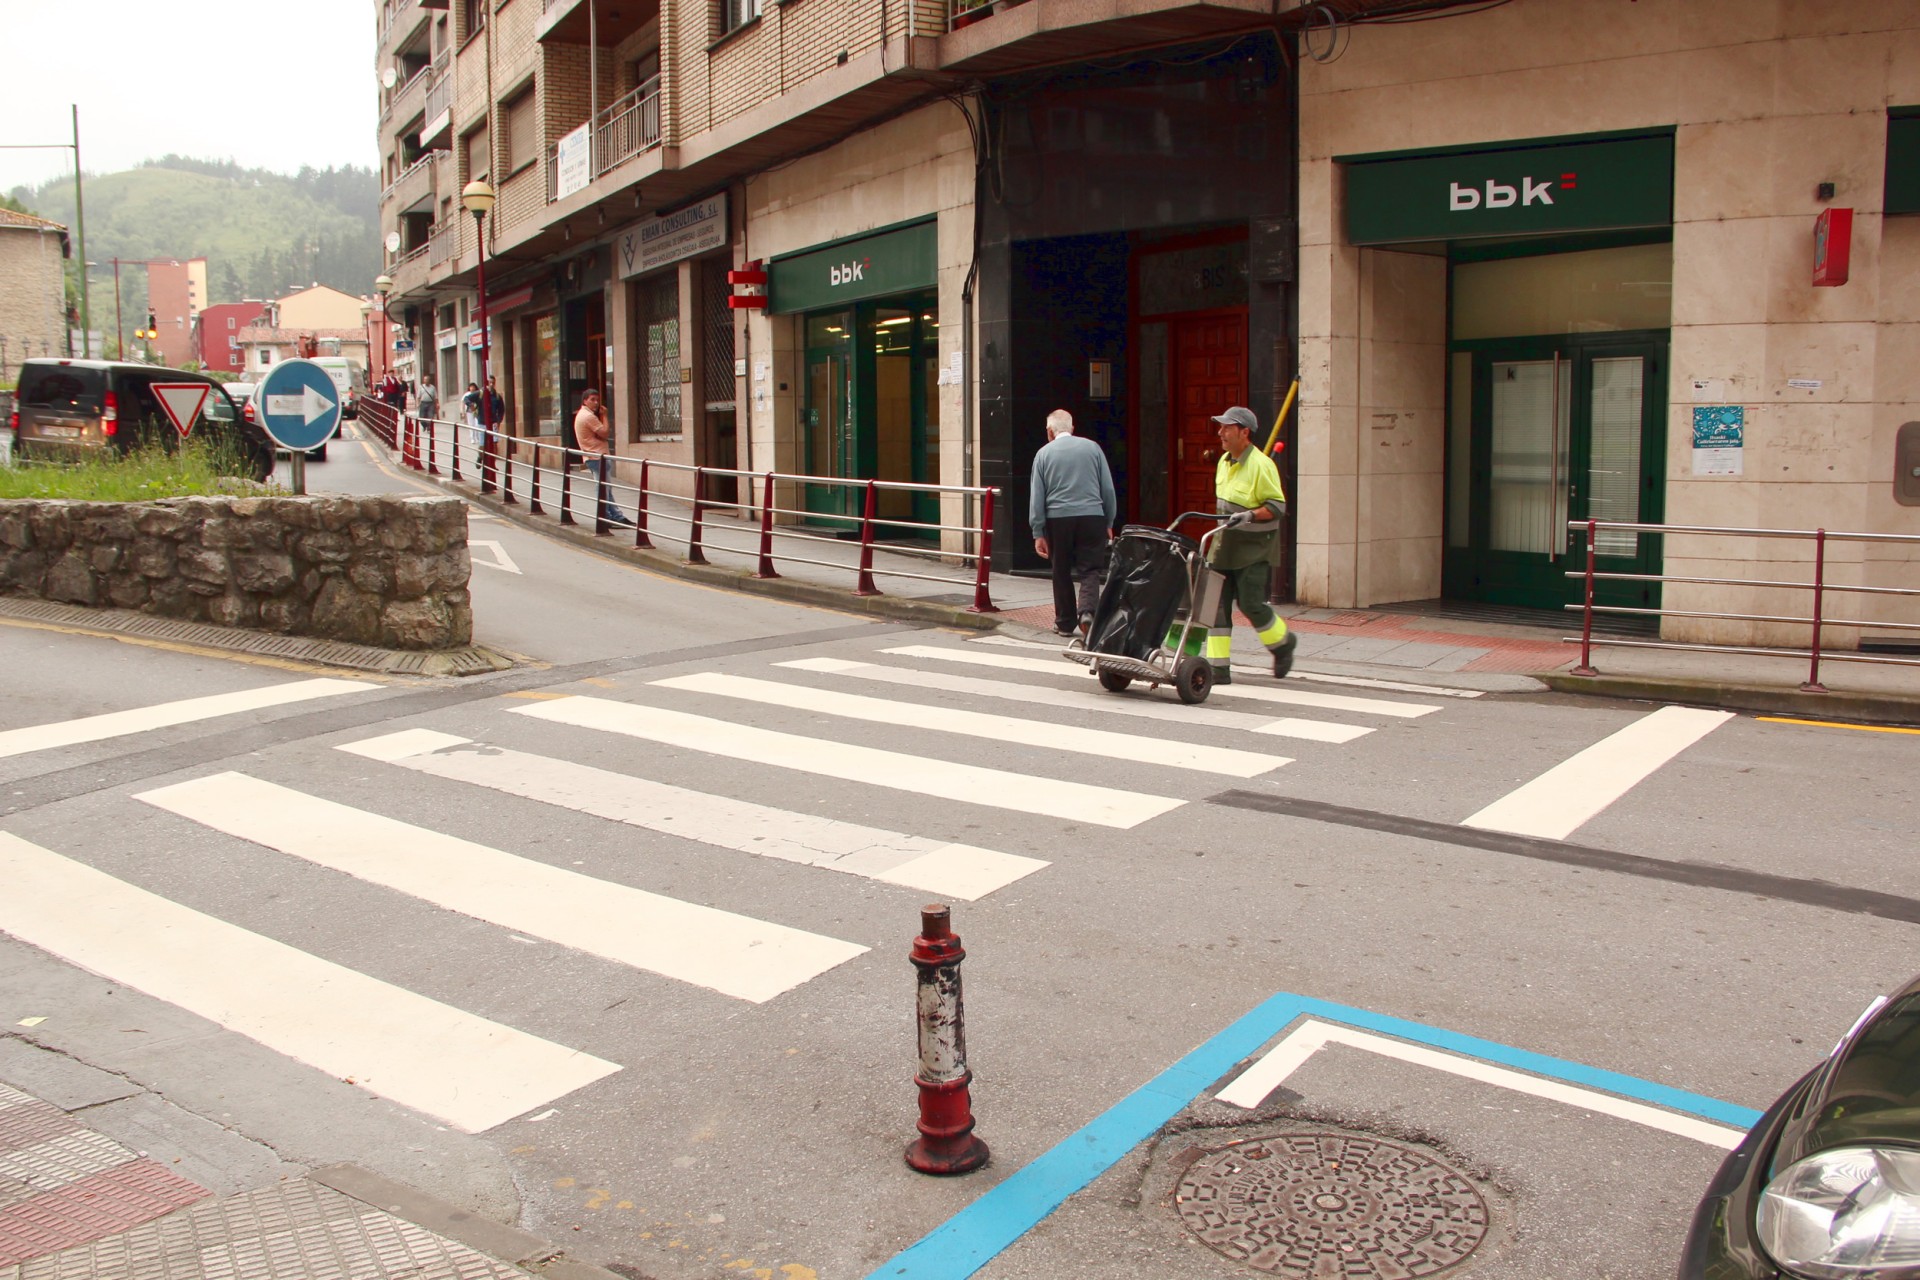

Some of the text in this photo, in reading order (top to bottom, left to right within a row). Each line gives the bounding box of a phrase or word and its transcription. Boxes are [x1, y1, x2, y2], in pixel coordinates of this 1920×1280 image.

[1450, 176, 1554, 211] bbk
[641, 224, 661, 242] EMAN
[661, 204, 706, 233] CONSULTING,
[831, 260, 864, 286] bbk
